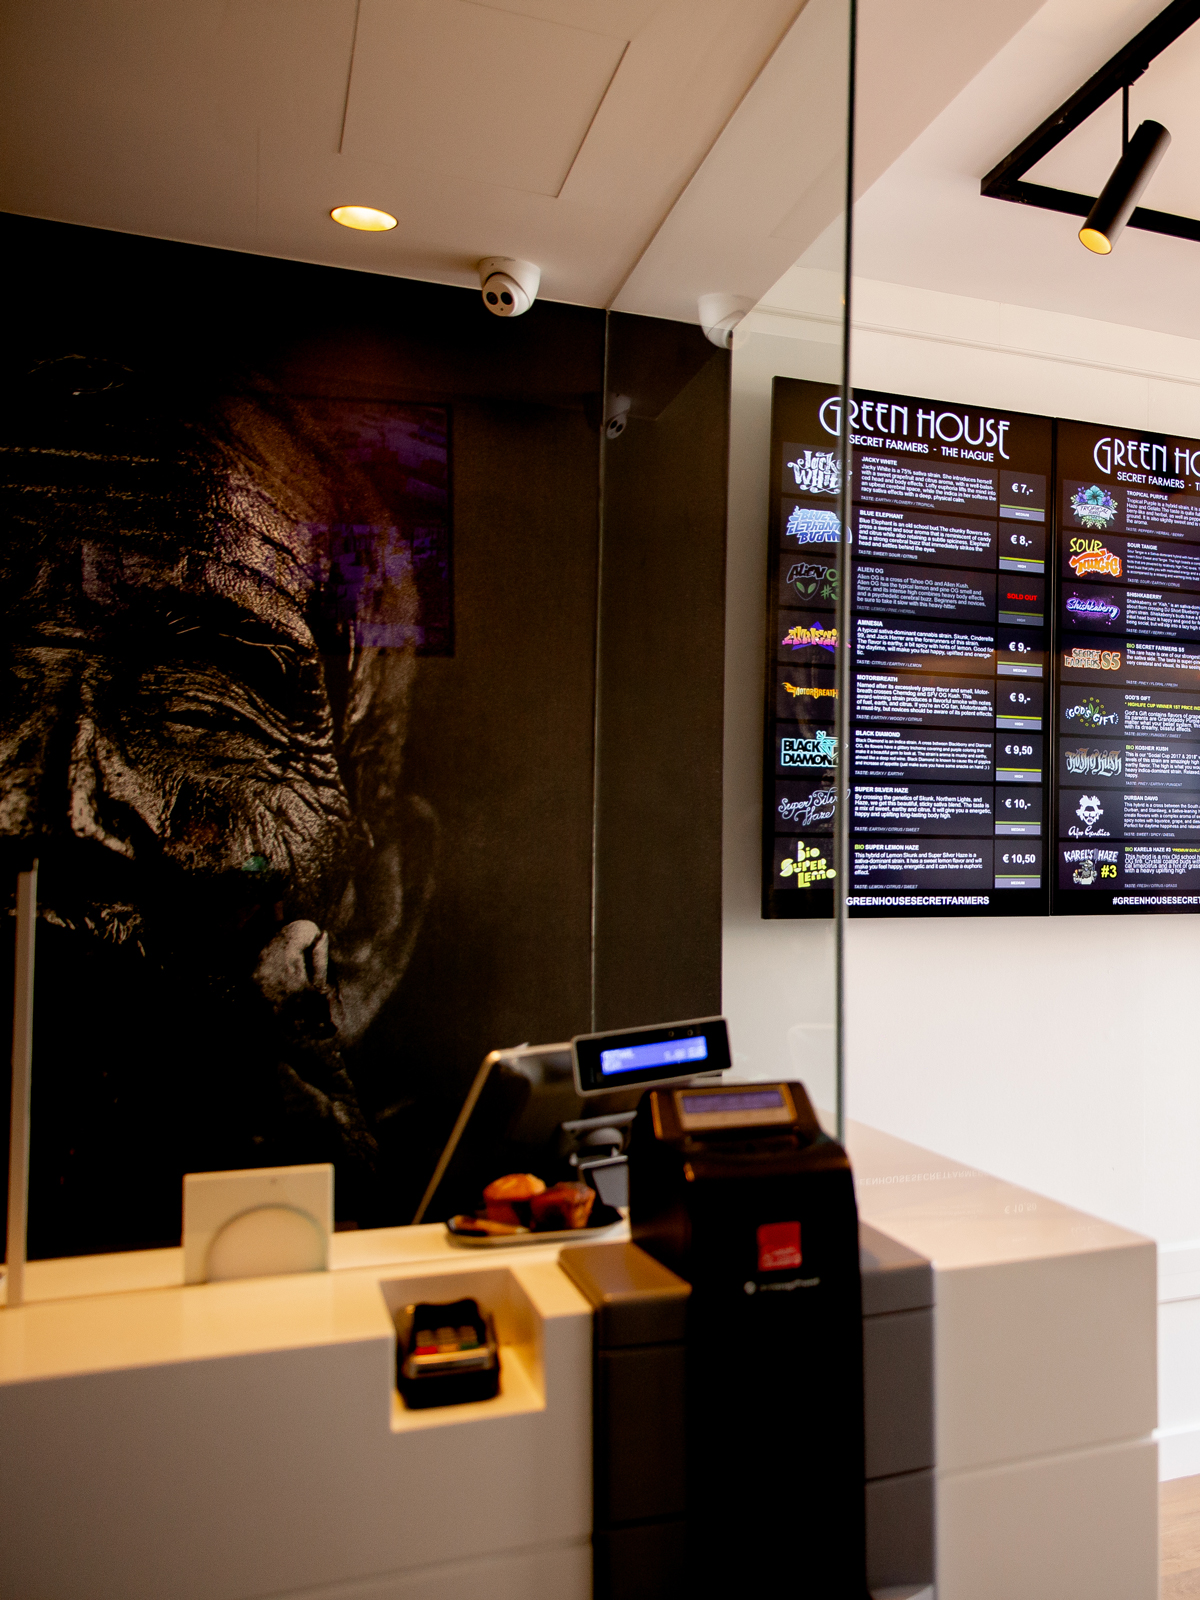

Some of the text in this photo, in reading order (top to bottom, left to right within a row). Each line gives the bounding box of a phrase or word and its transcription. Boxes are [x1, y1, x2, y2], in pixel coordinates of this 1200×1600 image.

[819, 397, 1010, 459] GREEN HOUSE
[850, 434, 994, 462] SECRET FARMERS THE HAGUE
[1094, 437, 1166, 474] GREEN
[862, 456, 879, 465] JACKY
[1117, 472, 1146, 484] SECRET
[1149, 476, 1185, 489] FARMERS
[1127, 491, 1148, 499] TROPICAL
[1070, 537, 1103, 555] SOUR
[1127, 592, 1162, 600] SHISHKABERRY
[1069, 706, 1115, 725] GOD'S GIFT
[783, 740, 820, 752] BLACK
[1064, 849, 1119, 862] KAREL'S HAZE
[1101, 865, 1117, 878] #3
